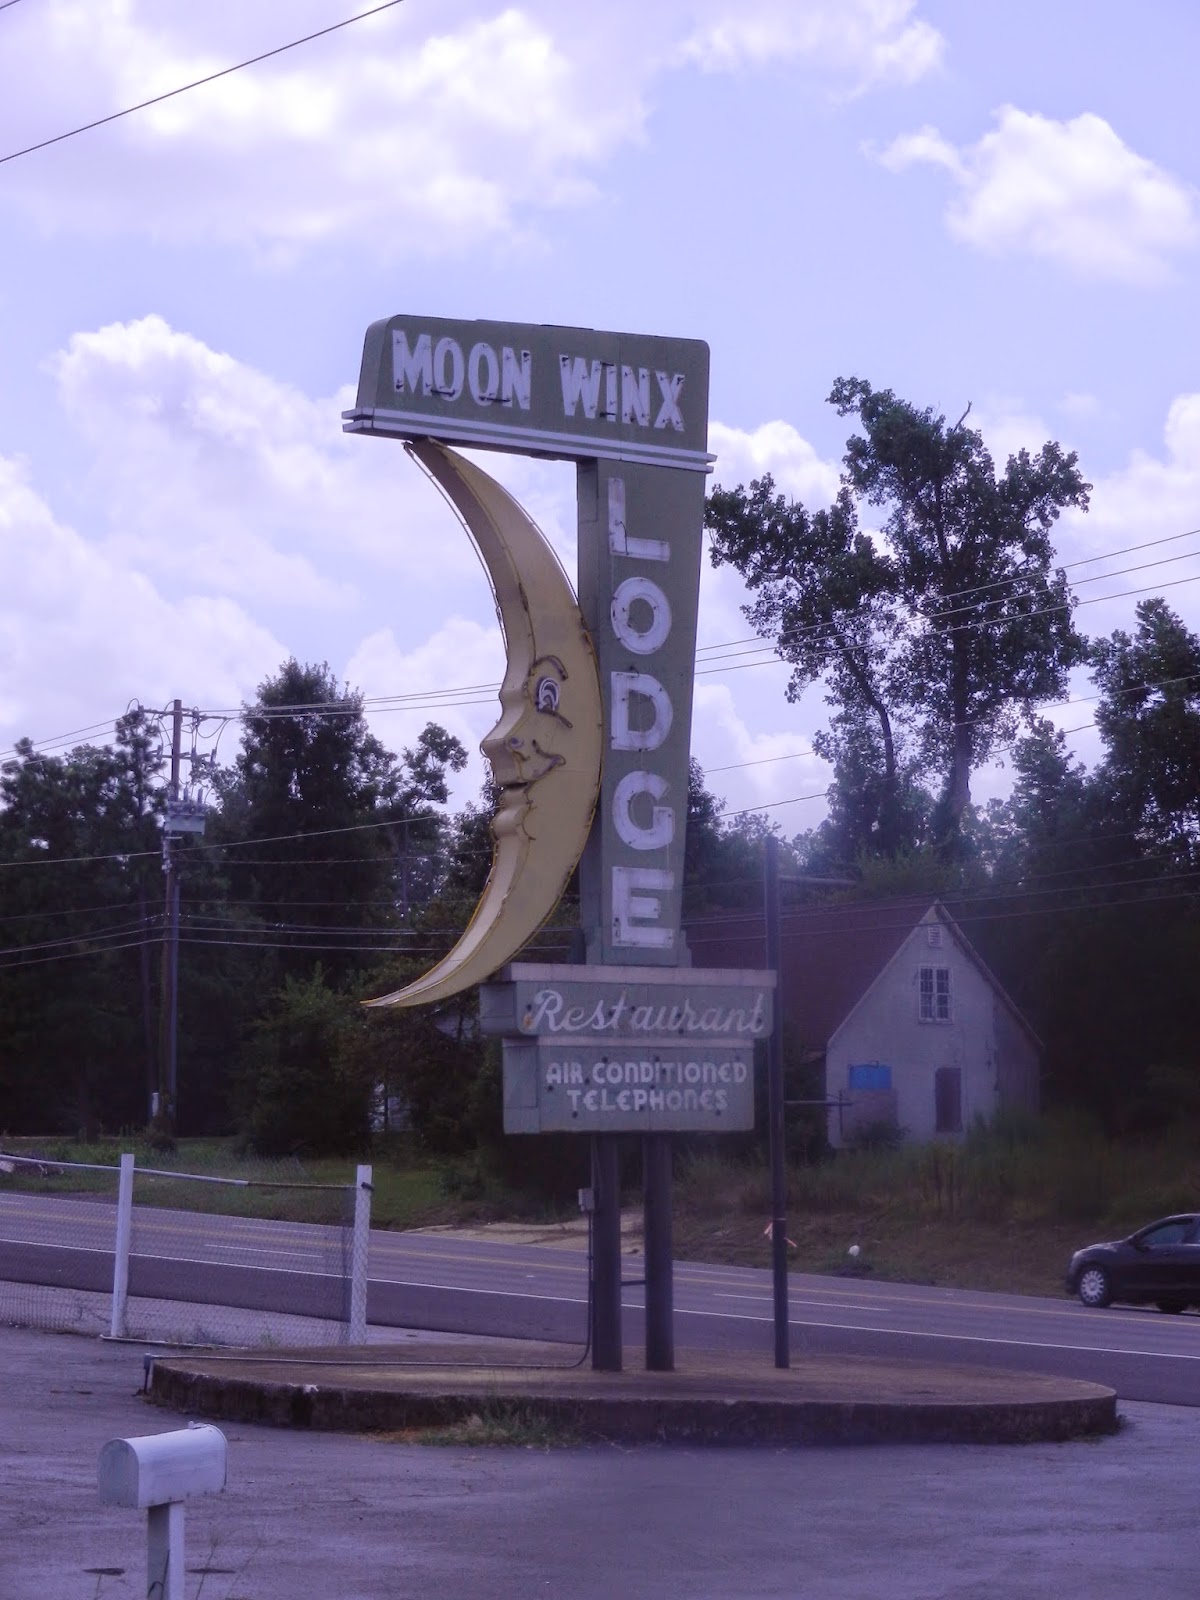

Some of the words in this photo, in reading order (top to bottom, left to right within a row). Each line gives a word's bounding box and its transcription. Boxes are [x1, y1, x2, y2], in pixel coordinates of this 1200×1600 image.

[392, 329, 531, 411] MOON
[559, 353, 686, 432] WINX
[608, 477, 675, 949] LODGE
[531, 988, 764, 1034] Restaurant
[546, 1062, 583, 1084] AIR
[592, 1062, 747, 1084] CONDITIONED
[567, 1089, 728, 1112] TELEPHONES
